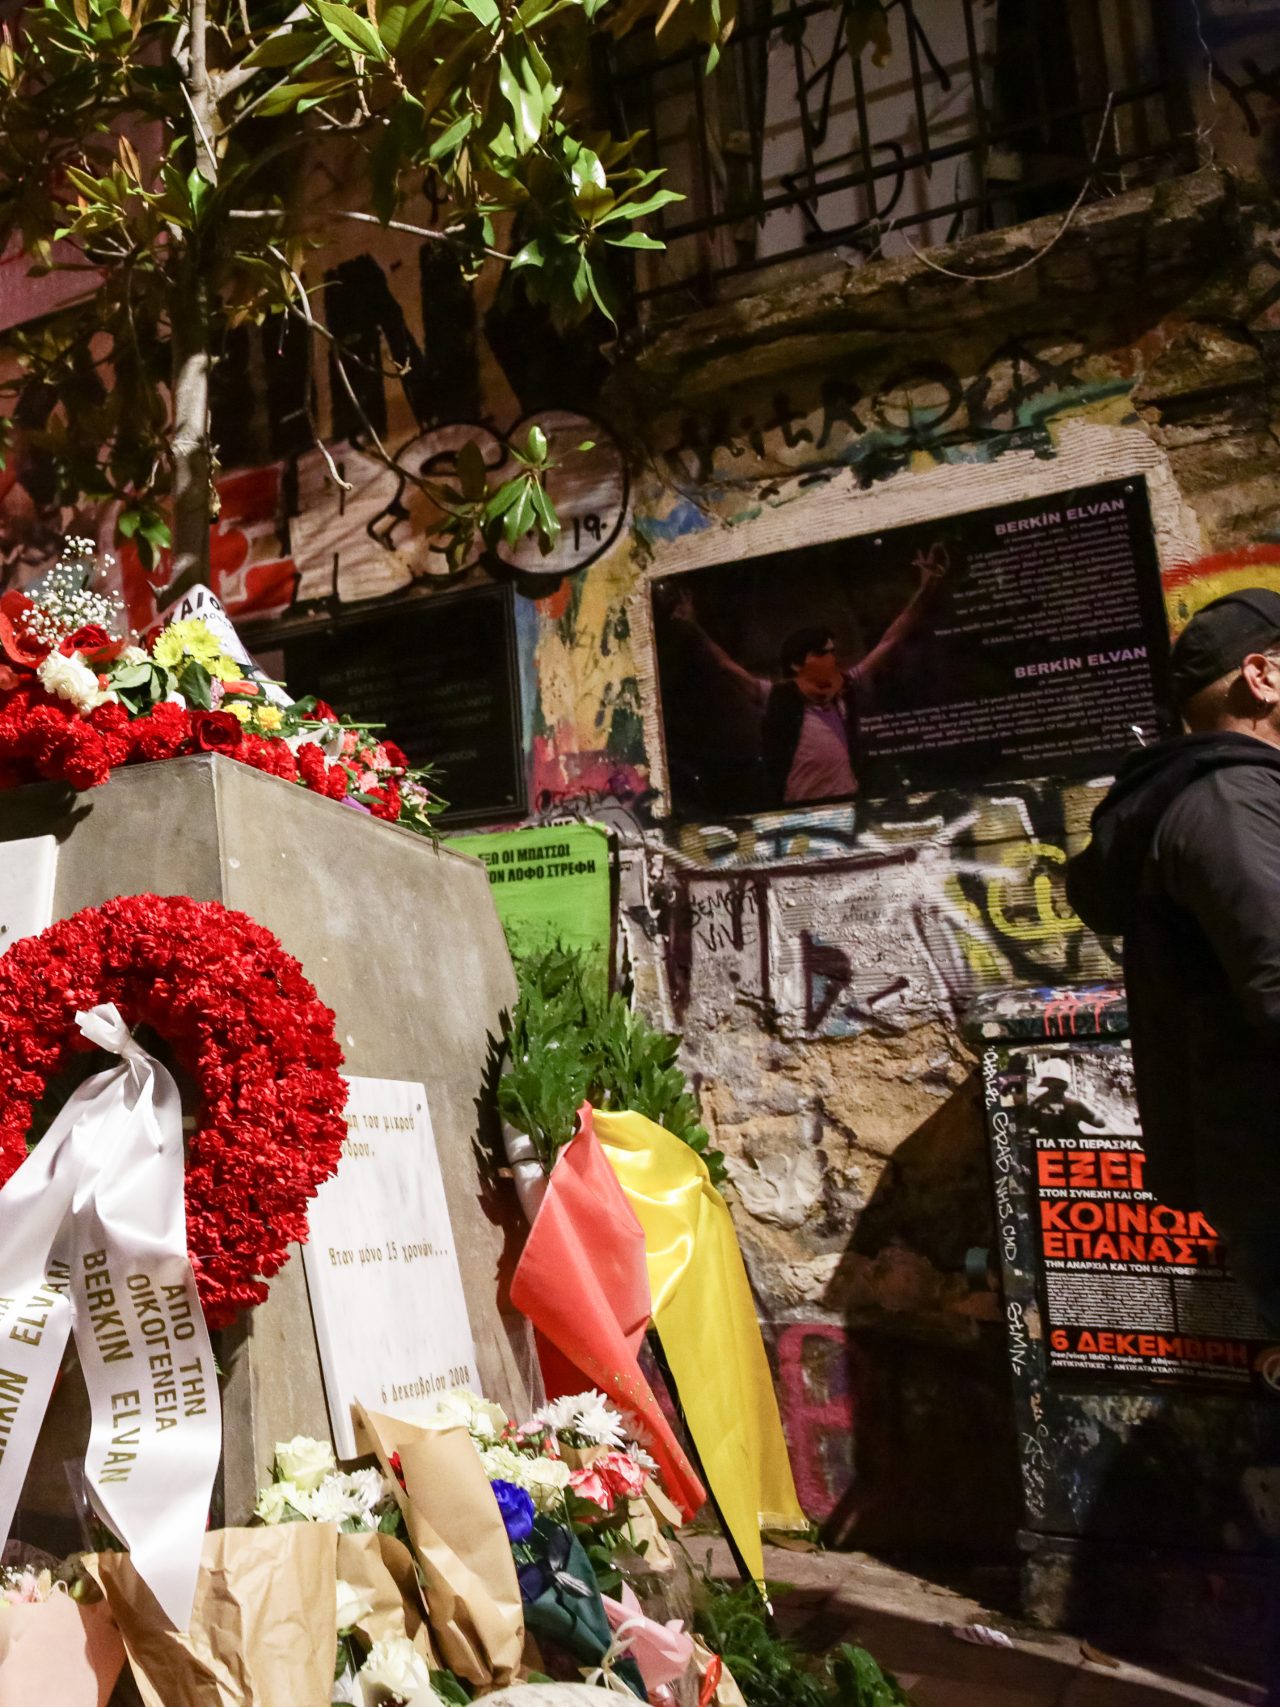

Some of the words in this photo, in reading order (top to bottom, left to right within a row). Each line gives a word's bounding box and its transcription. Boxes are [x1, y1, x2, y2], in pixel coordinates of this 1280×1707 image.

[1067, 499, 1125, 521] ELVAN
[1087, 646, 1148, 667] ELVAN
[503, 851, 514, 863] ΟΙ
[517, 844, 570, 861] ΜΠΑΤΣΟΙ
[508, 865, 544, 882] ΛΟΦΟ
[547, 860, 596, 877] ΣΤΡΕΦΗ
[1036, 1138, 1058, 1149] ΓΙΑ
[1060, 1138, 1077, 1149] ΤΟ
[1039, 1188, 1068, 1198] ΣΤΟΝ
[1070, 1189, 1111, 1199] ΣΥΝΕΧΗ
[1113, 1191, 1131, 1200] ΚΑΙ
[386, 1242, 398, 1261] 15
[1044, 1260, 1065, 1269] ΤΗΝ
[1066, 1261, 1108, 1271] ΑΝΑΡΧΙΑ
[1110, 1263, 1128, 1272] ΚΑΙ
[1130, 1264, 1150, 1273] ΤΟΝ
[82, 1249, 134, 1364] BERKIN
[160, 1284, 196, 1340] ΑΠΟ
[180, 1357, 207, 1417] ΤΗΝ
[1050, 1329, 1069, 1351] 6
[126, 1273, 178, 1433] ΟΙΚΟΓΕΝΕΙΑ
[381, 1384, 387, 1405] 6
[449, 1365, 470, 1388] 2008
[98, 1388, 141, 1484] ELVAN
